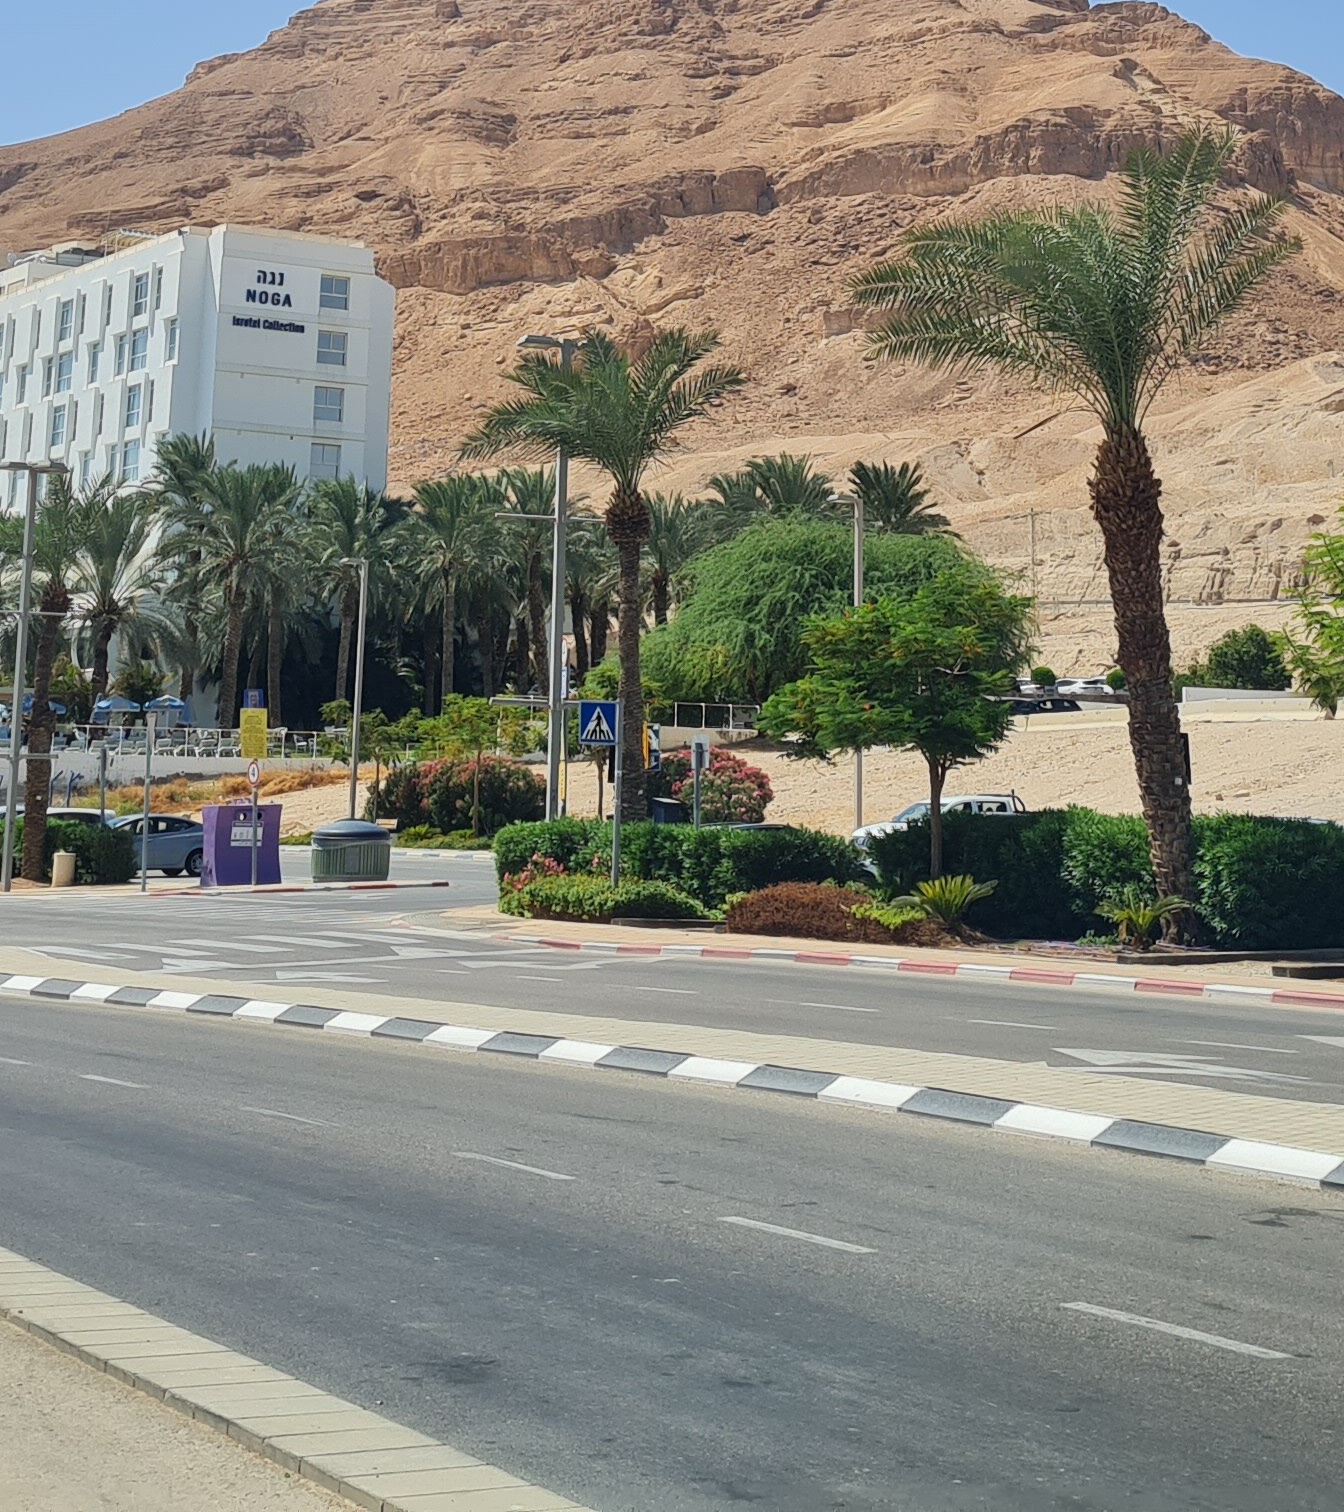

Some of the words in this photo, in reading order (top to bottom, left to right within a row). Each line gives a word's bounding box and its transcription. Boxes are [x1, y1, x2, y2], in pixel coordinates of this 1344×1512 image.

[257, 270, 284, 286] נגה
[246, 289, 292, 307] NOGA
[233, 315, 260, 328] Isrotel
[263, 320, 305, 333] Collection
